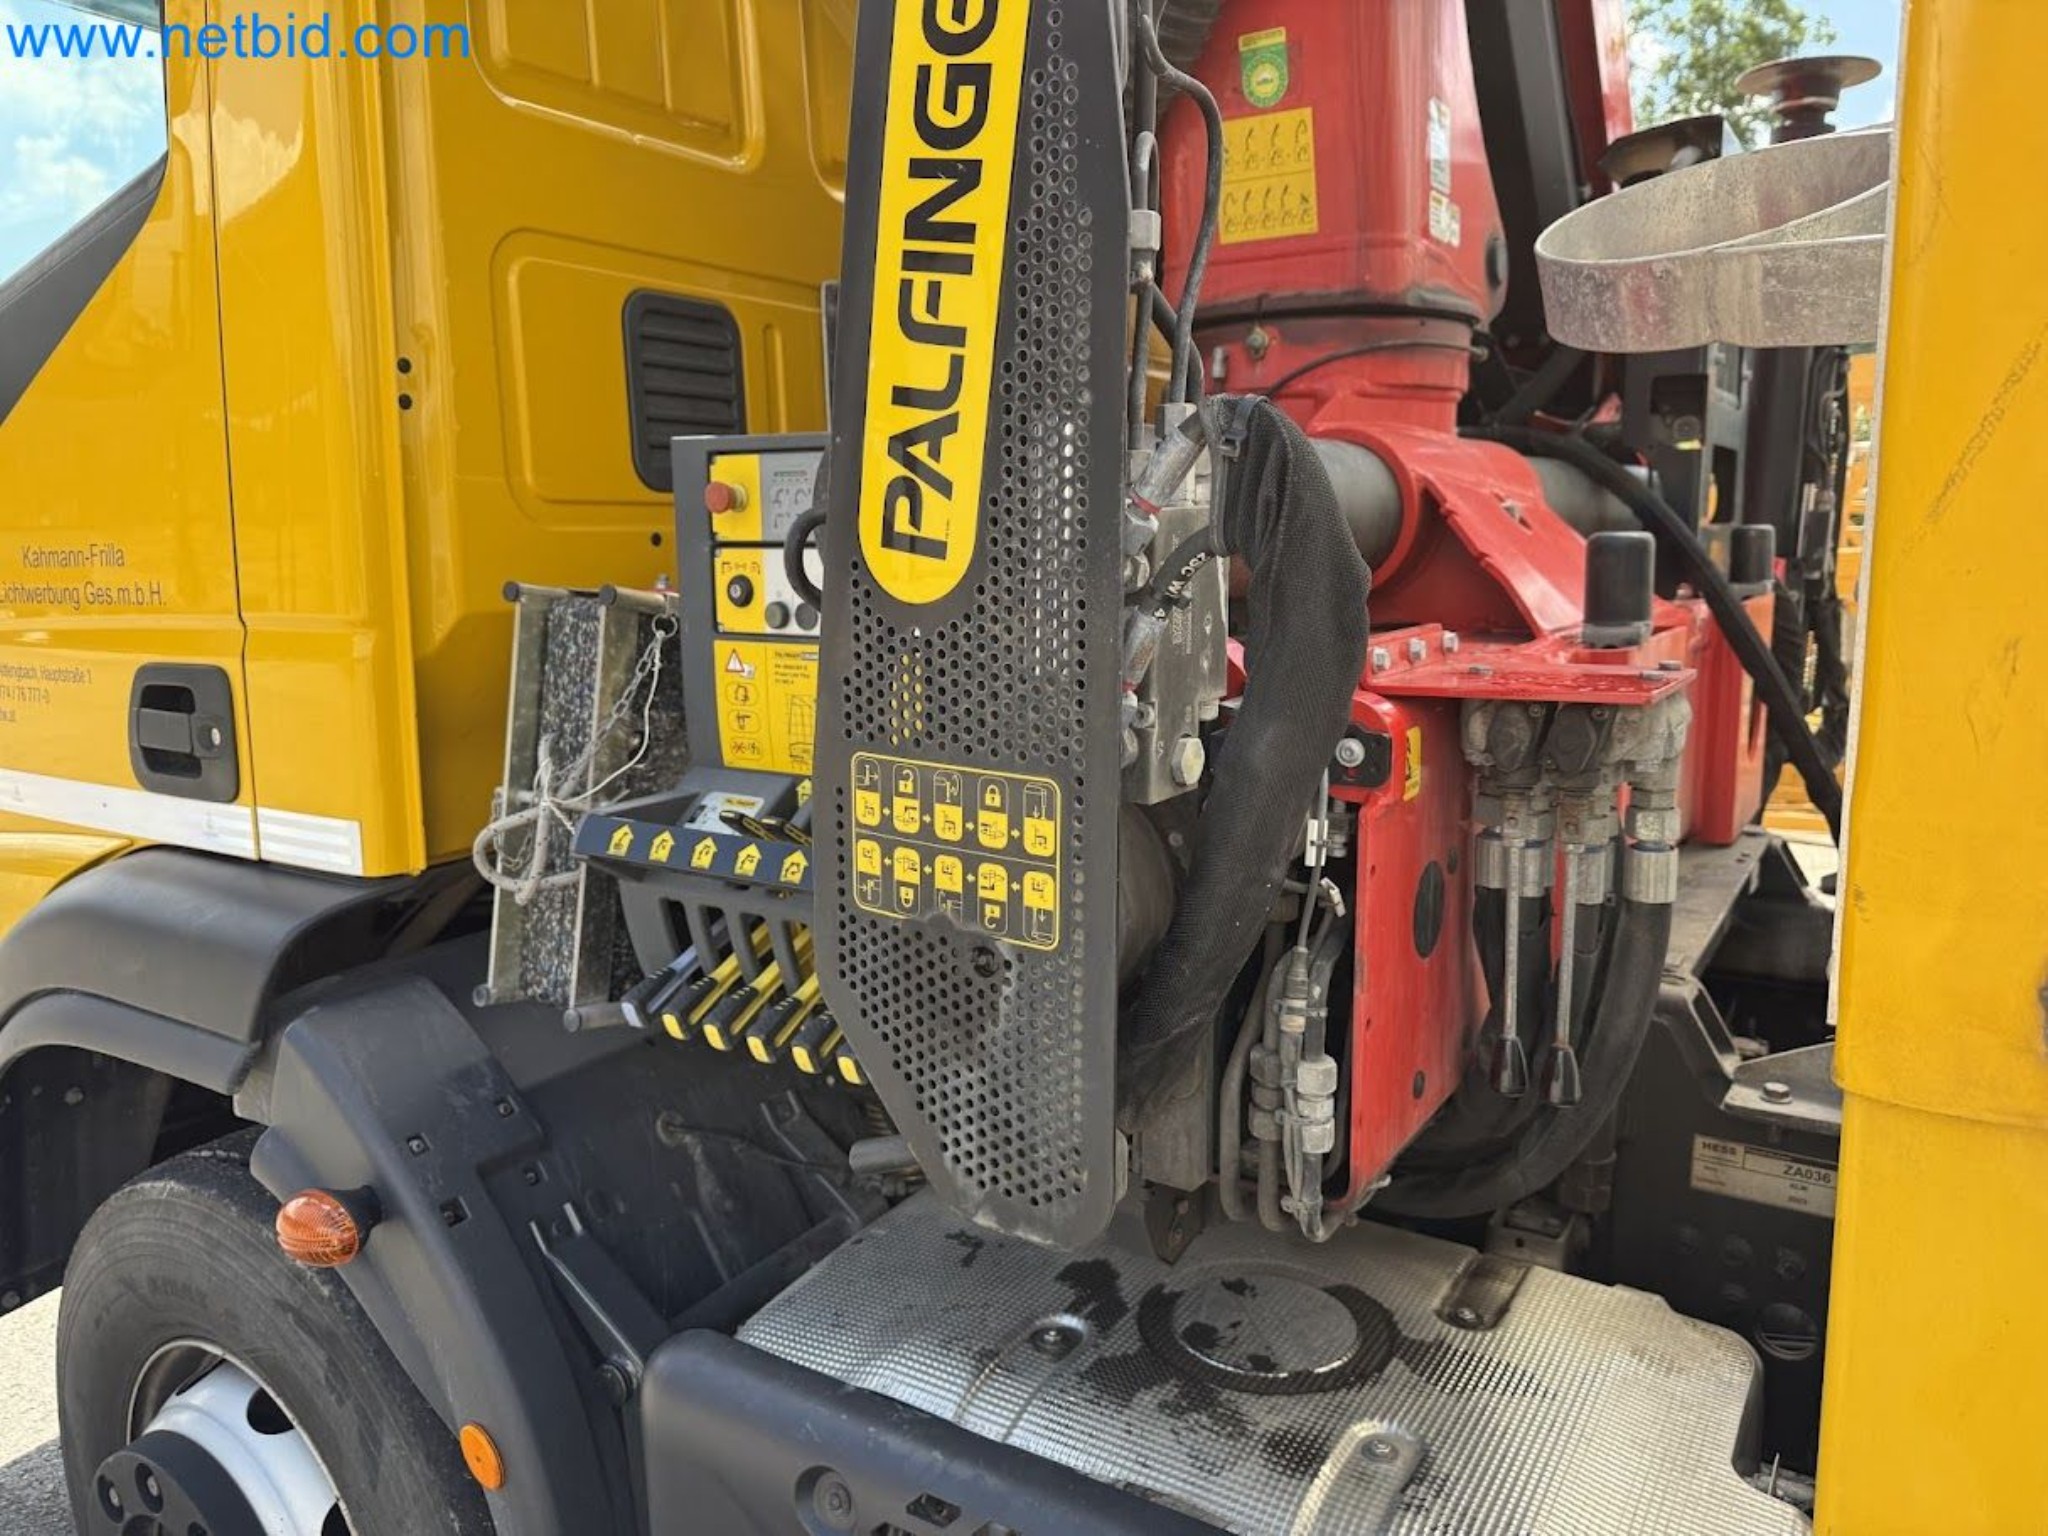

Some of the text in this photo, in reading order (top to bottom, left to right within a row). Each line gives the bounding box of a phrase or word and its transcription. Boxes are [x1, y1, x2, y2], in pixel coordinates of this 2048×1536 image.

[22, 543, 126, 569] Kahmann-Frilla
[84, 581, 167, 607] Ges.m.b.H.
[1701, 1140, 1738, 1156] HESS
